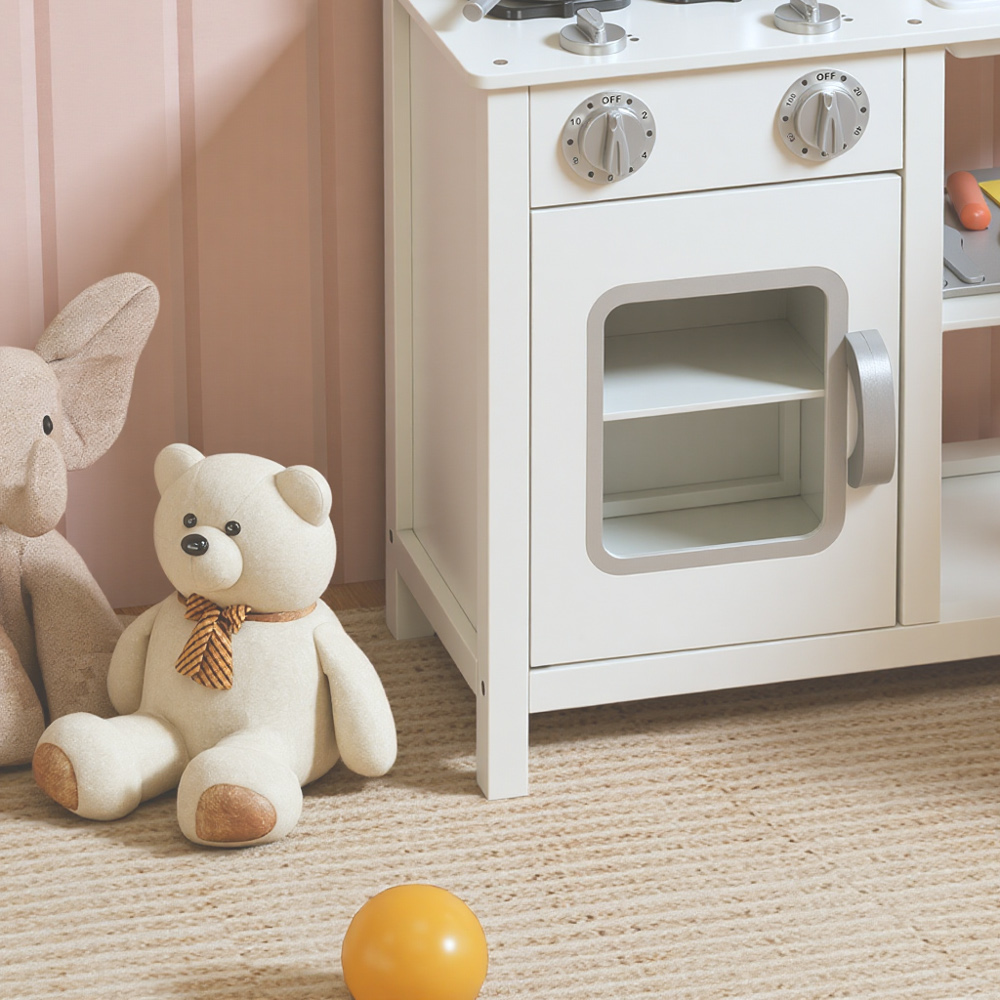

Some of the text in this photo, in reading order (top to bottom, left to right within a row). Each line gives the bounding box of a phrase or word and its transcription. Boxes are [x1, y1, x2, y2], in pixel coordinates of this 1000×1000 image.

[816, 72, 836, 81] OFF
[602, 95, 622, 105] OFF
[641, 111, 648, 120] 2
[570, 117, 582, 126] 10
